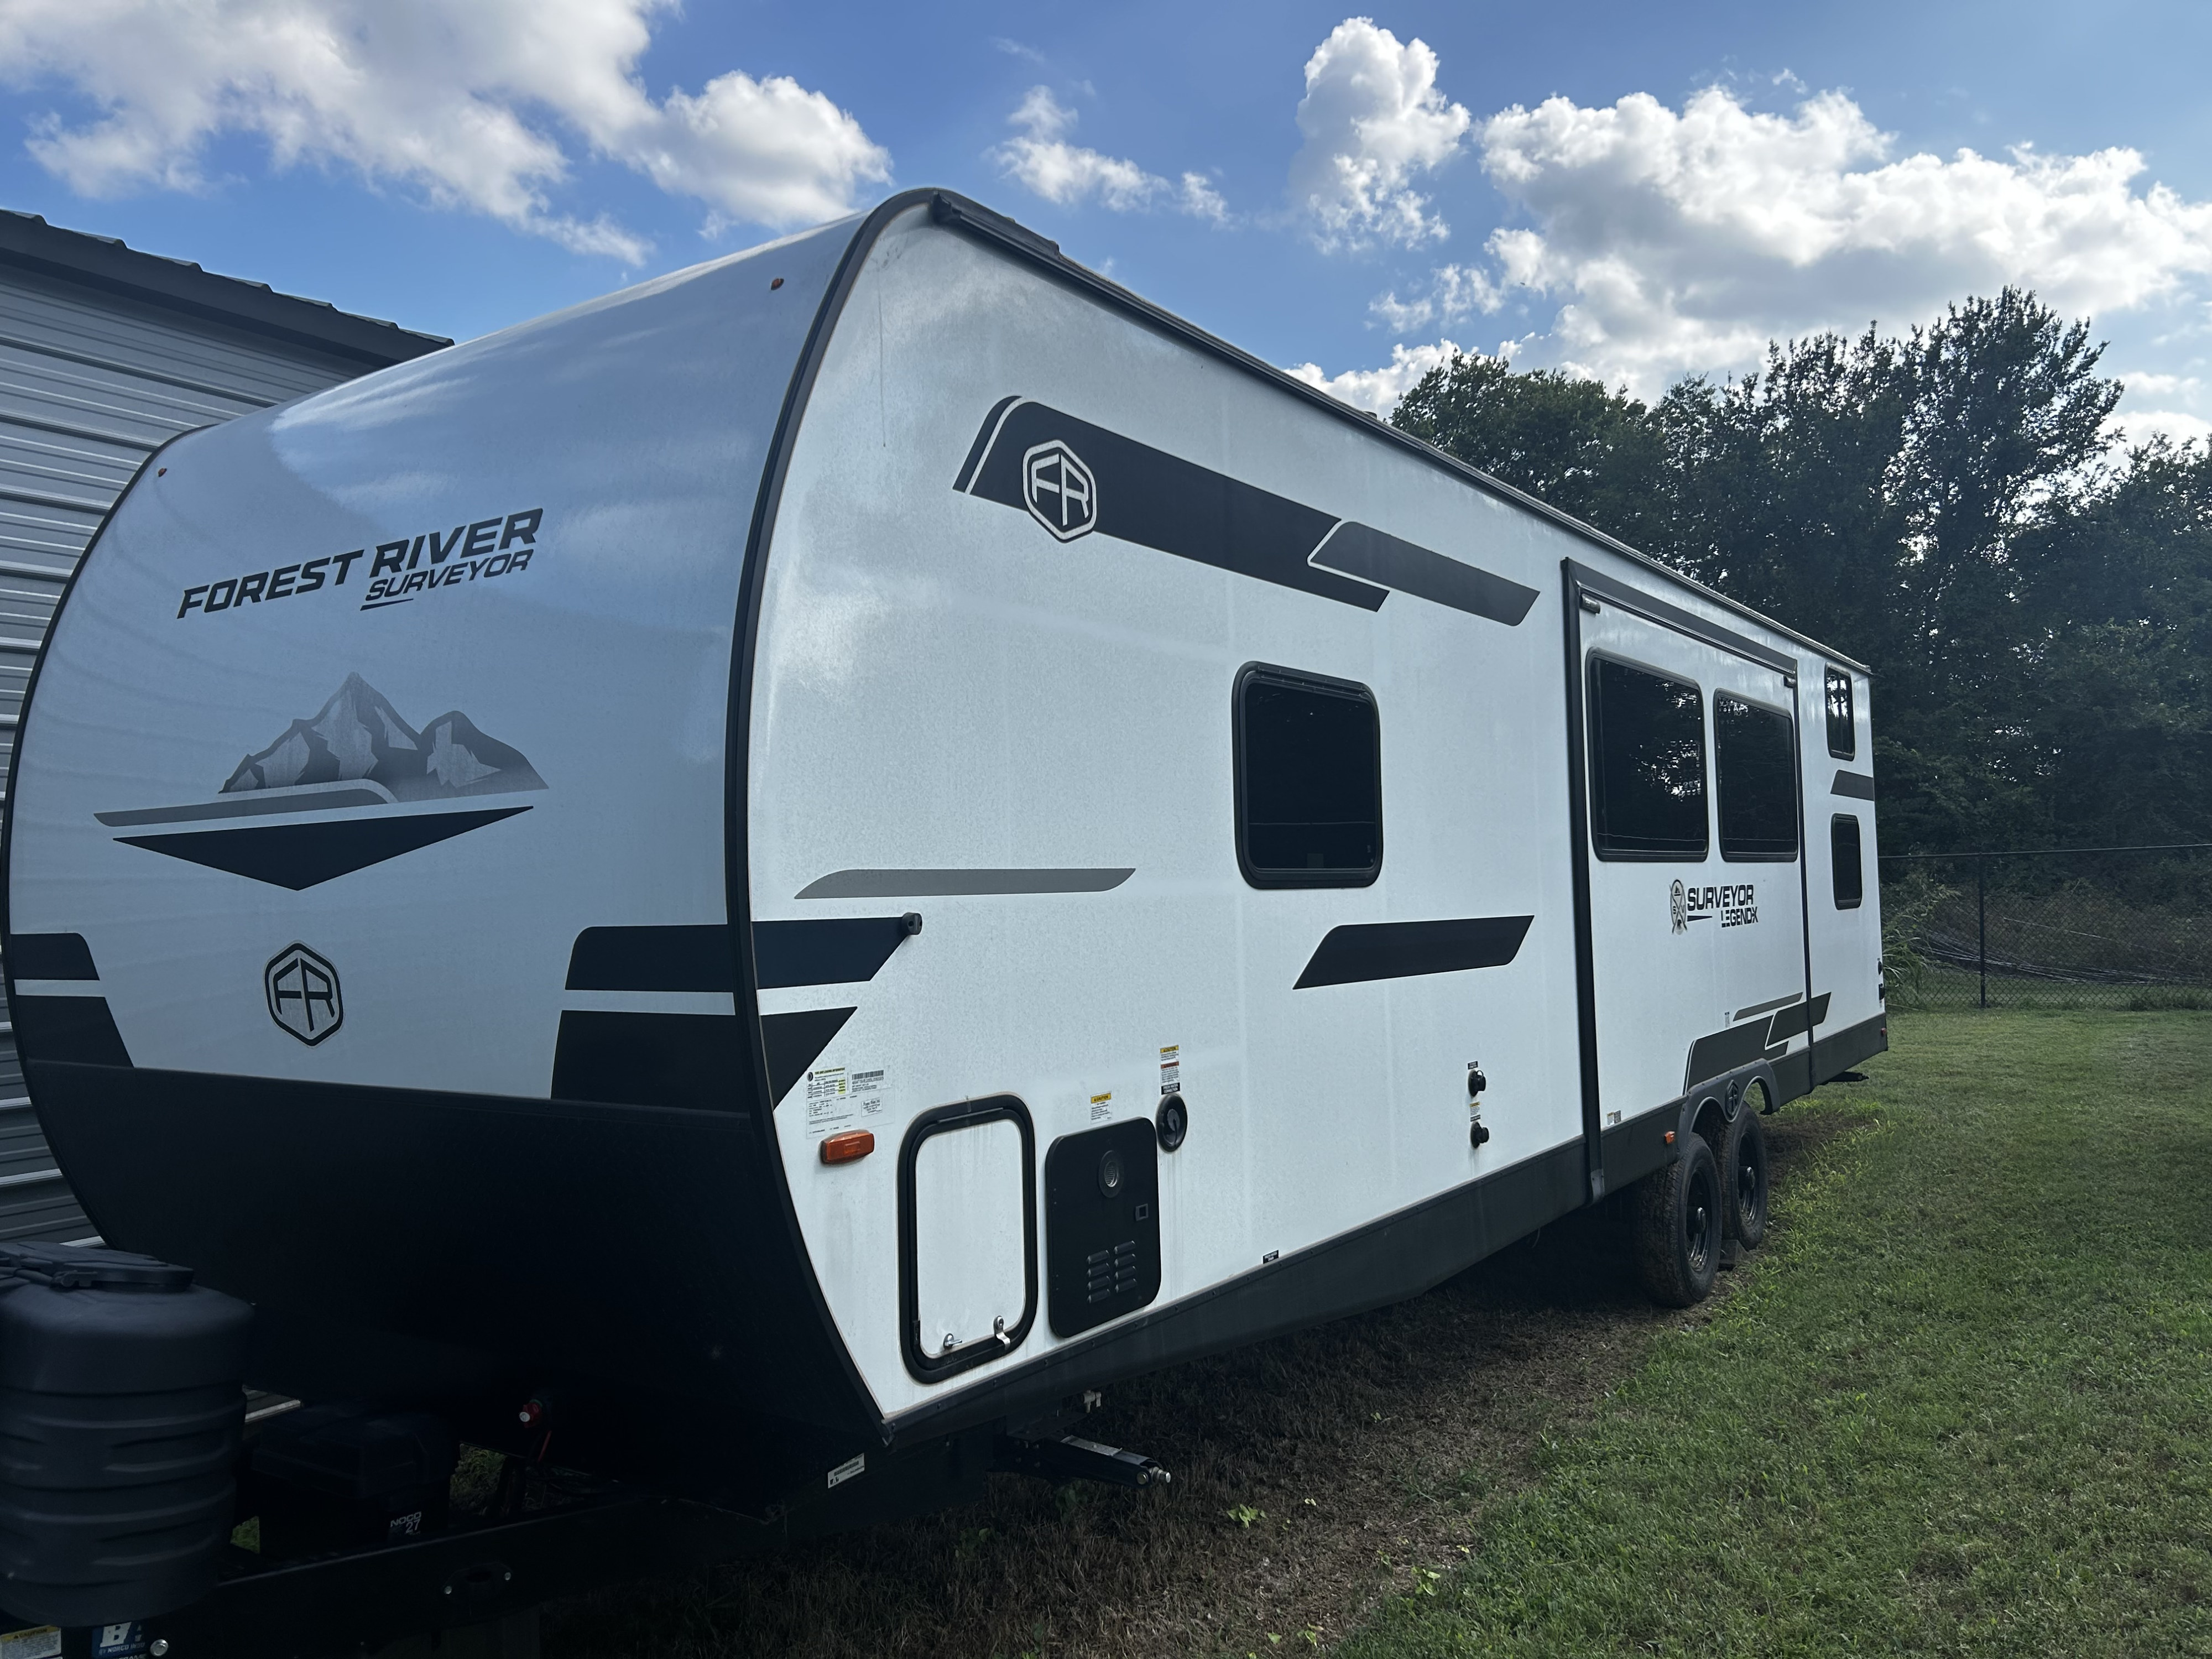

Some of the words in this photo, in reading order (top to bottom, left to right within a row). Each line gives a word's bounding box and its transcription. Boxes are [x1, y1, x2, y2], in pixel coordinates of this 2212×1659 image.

[176, 549, 365, 619] FOREST
[369, 508, 543, 578] RIVER
[364, 549, 534, 601] SURVEYOR
[1687, 884, 1754, 911] SURVEYOR
[390, 1511, 422, 1528] NOCO
[405, 1517, 421, 1533] 27
[107, 1644, 129, 1653] NORCO
